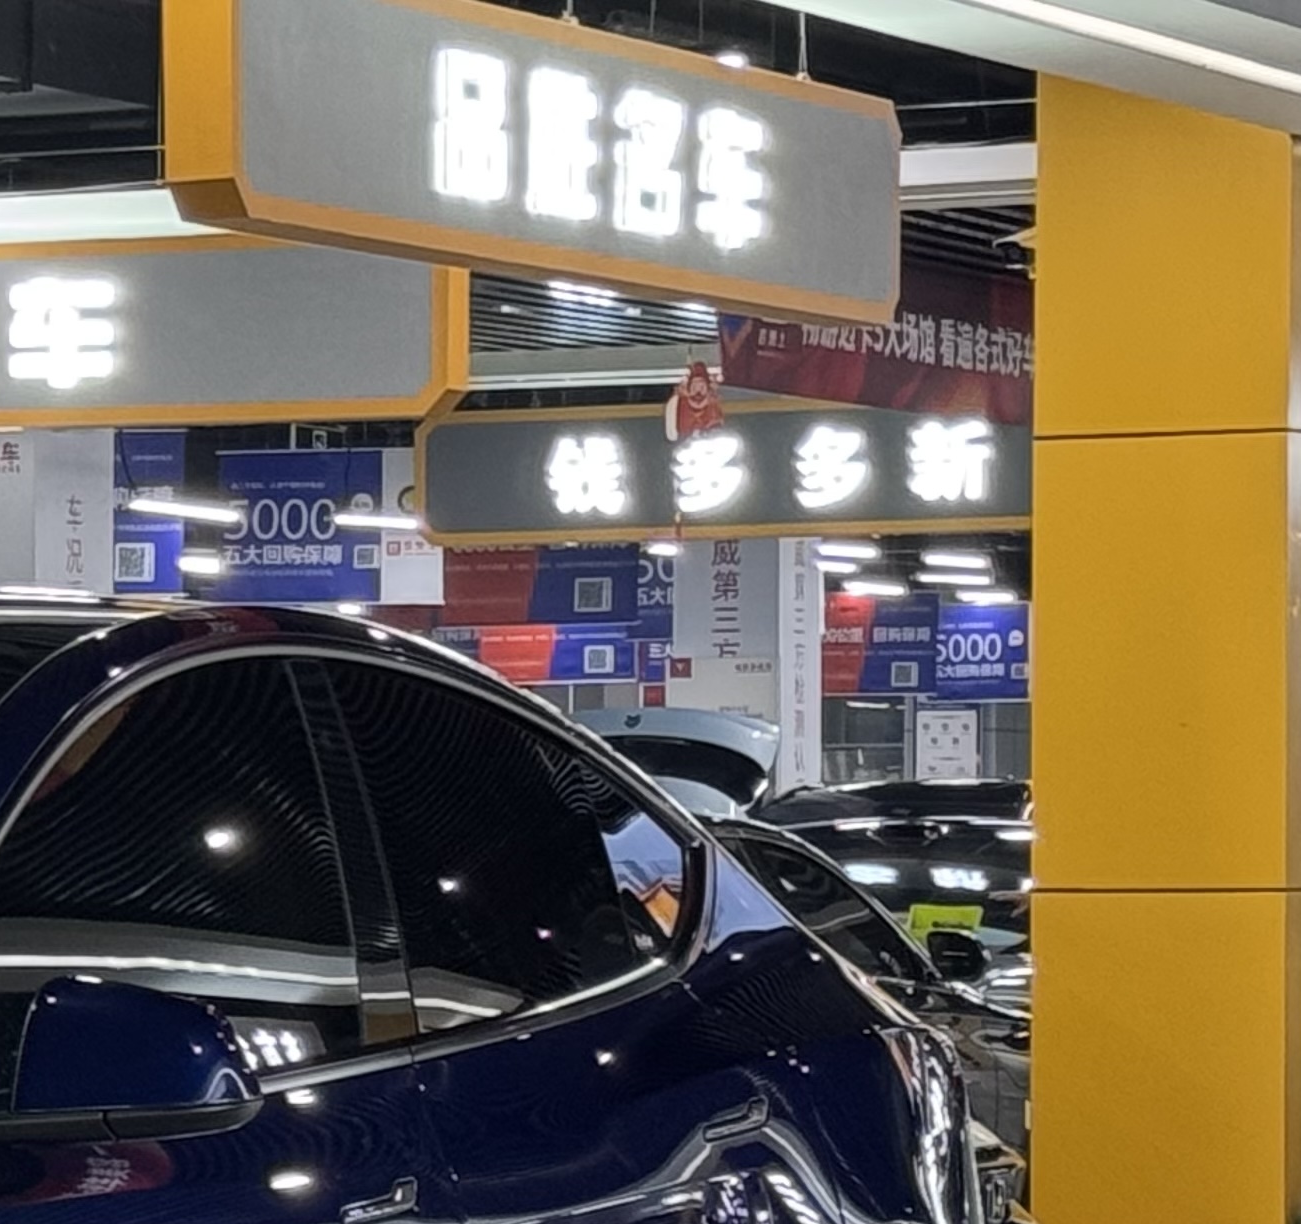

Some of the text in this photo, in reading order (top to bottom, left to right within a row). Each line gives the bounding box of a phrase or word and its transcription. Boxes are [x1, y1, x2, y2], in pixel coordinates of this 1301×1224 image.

[432, 46, 766, 248] 品胜名车
[548, 420, 994, 516] 钱多多新
[223, 499, 337, 540] 5000
